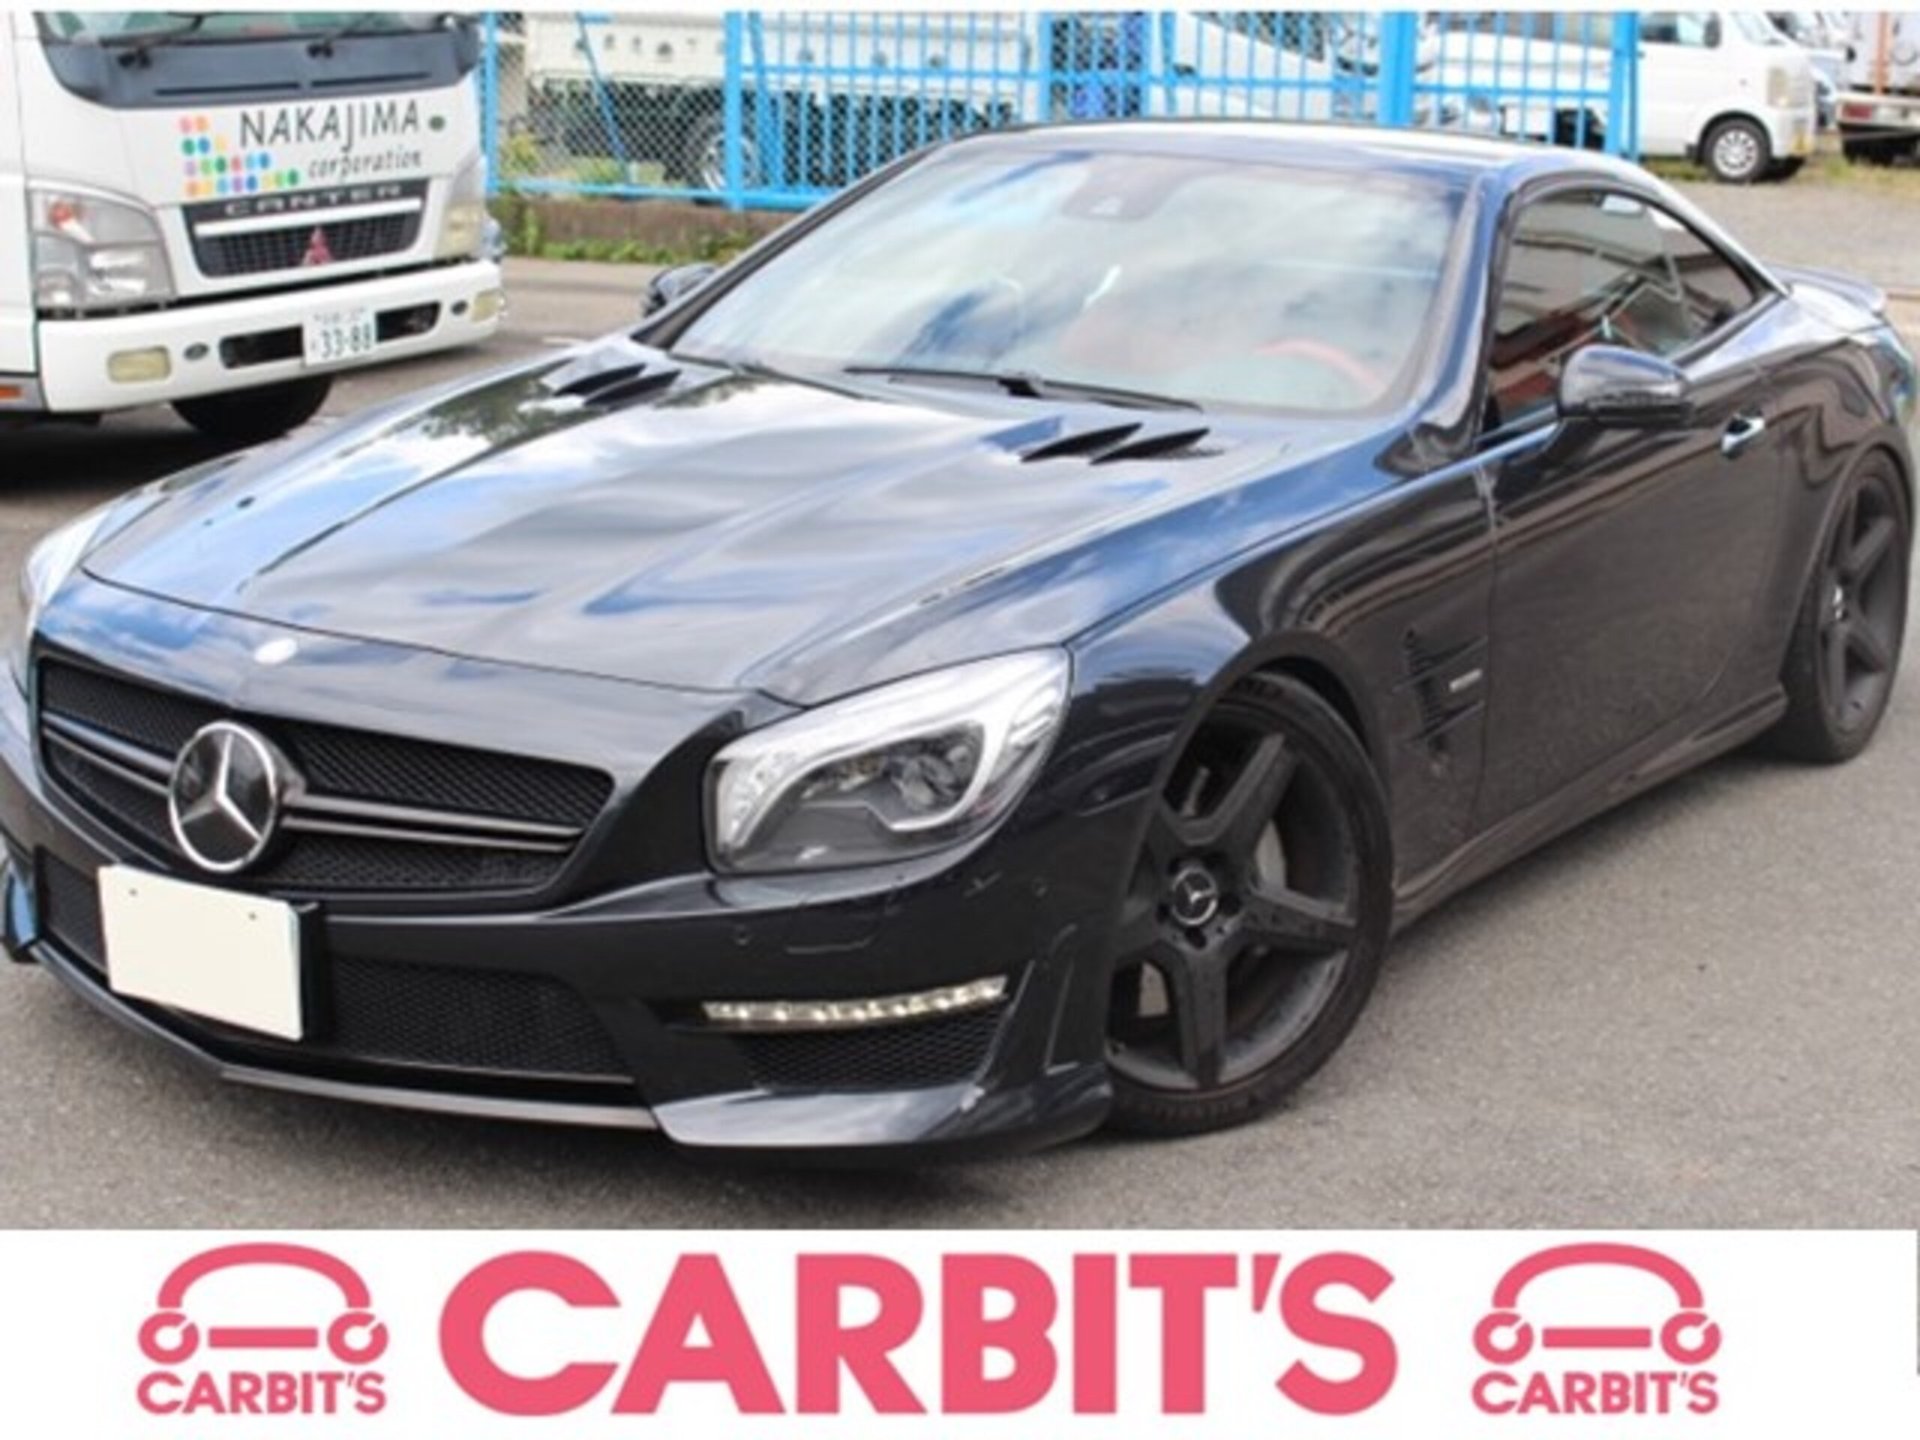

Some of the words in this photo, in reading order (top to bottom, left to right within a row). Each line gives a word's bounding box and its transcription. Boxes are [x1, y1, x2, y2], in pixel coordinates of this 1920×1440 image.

[240, 100, 420, 151] NAKAJIMA
[308, 150, 422, 182] corporation
[225, 184, 402, 217] CANTER
